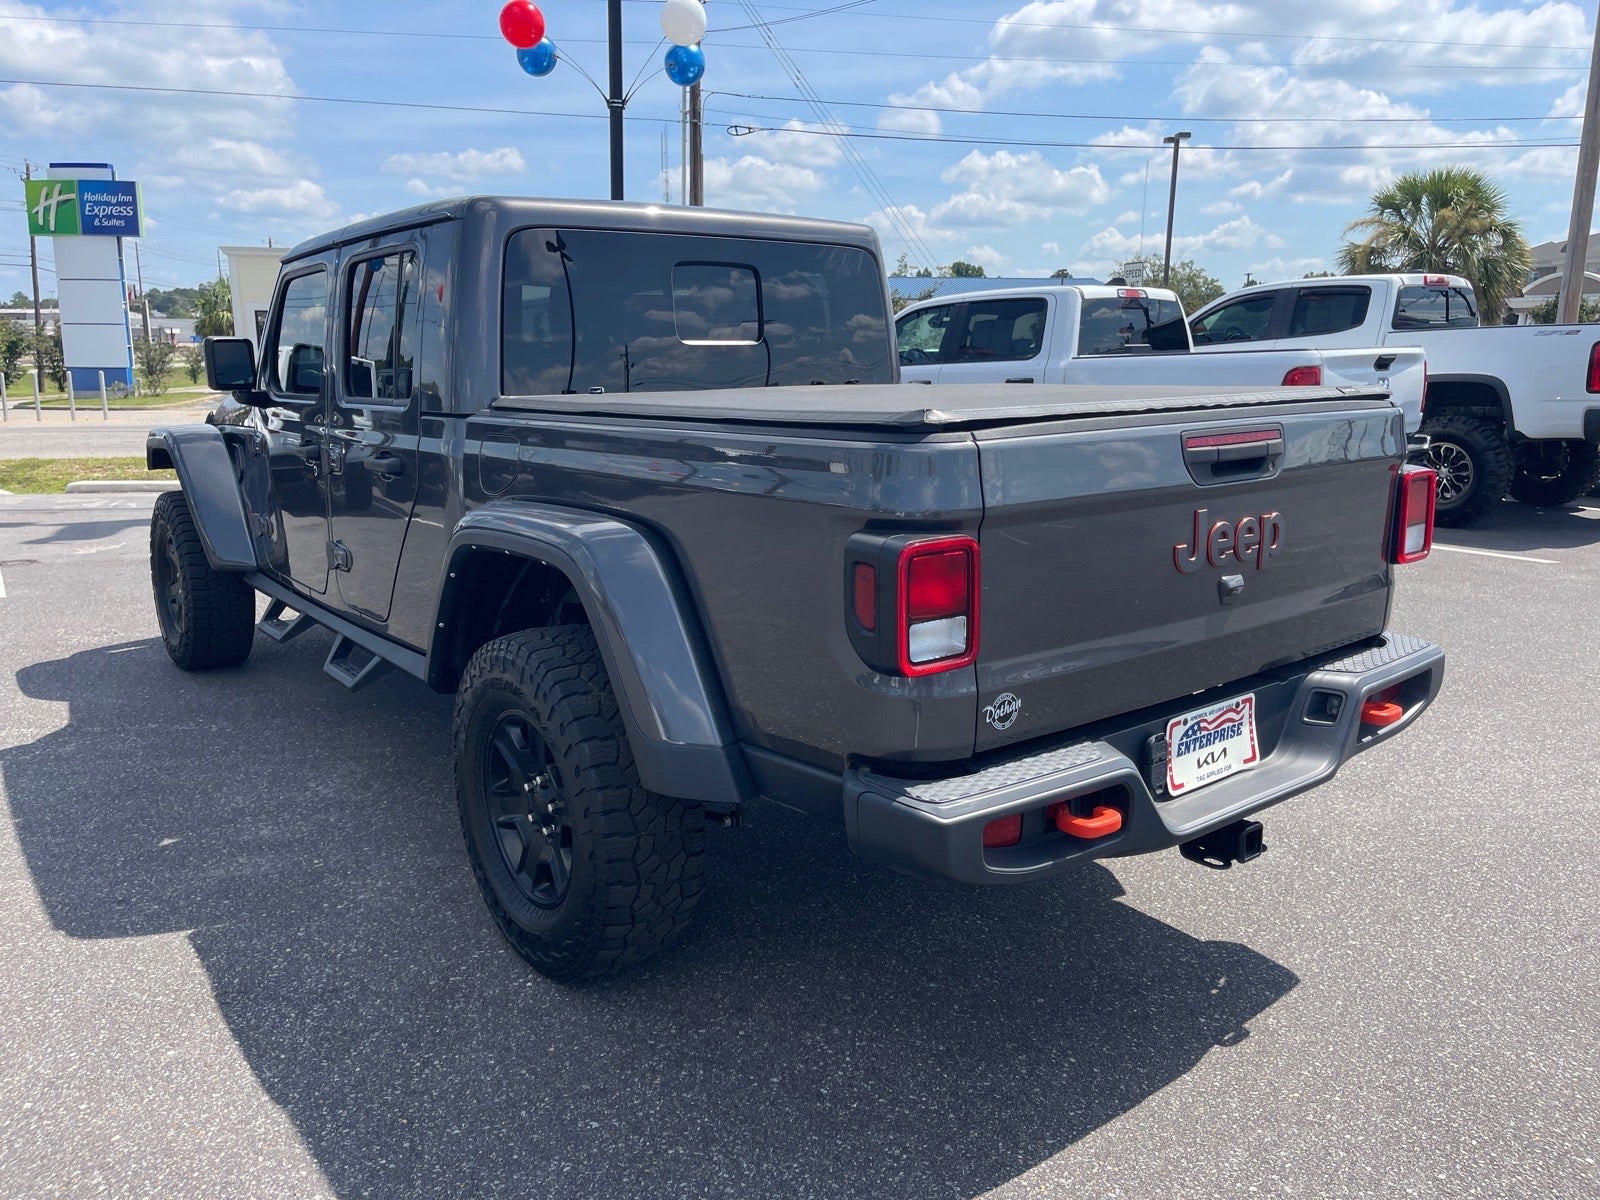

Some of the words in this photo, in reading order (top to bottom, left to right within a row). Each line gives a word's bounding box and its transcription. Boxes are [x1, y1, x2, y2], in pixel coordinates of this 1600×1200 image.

[84, 191, 118, 204] Holiday
[118, 192, 133, 203] Inn
[85, 202, 134, 218] Express
[93, 217, 101, 226] &
[101, 217, 125, 227] Suites
[1125, 269, 1141, 278] SPEED
[1173, 508, 1285, 575] Jeep
[982, 698, 1022, 723] Dothan
[1176, 722, 1243, 758] ENTERPRISE
[1196, 747, 1228, 769] KIA
[1196, 774, 1206, 783] TAG
[1206, 767, 1224, 778] APPLIED
[1223, 764, 1232, 773] FOR
